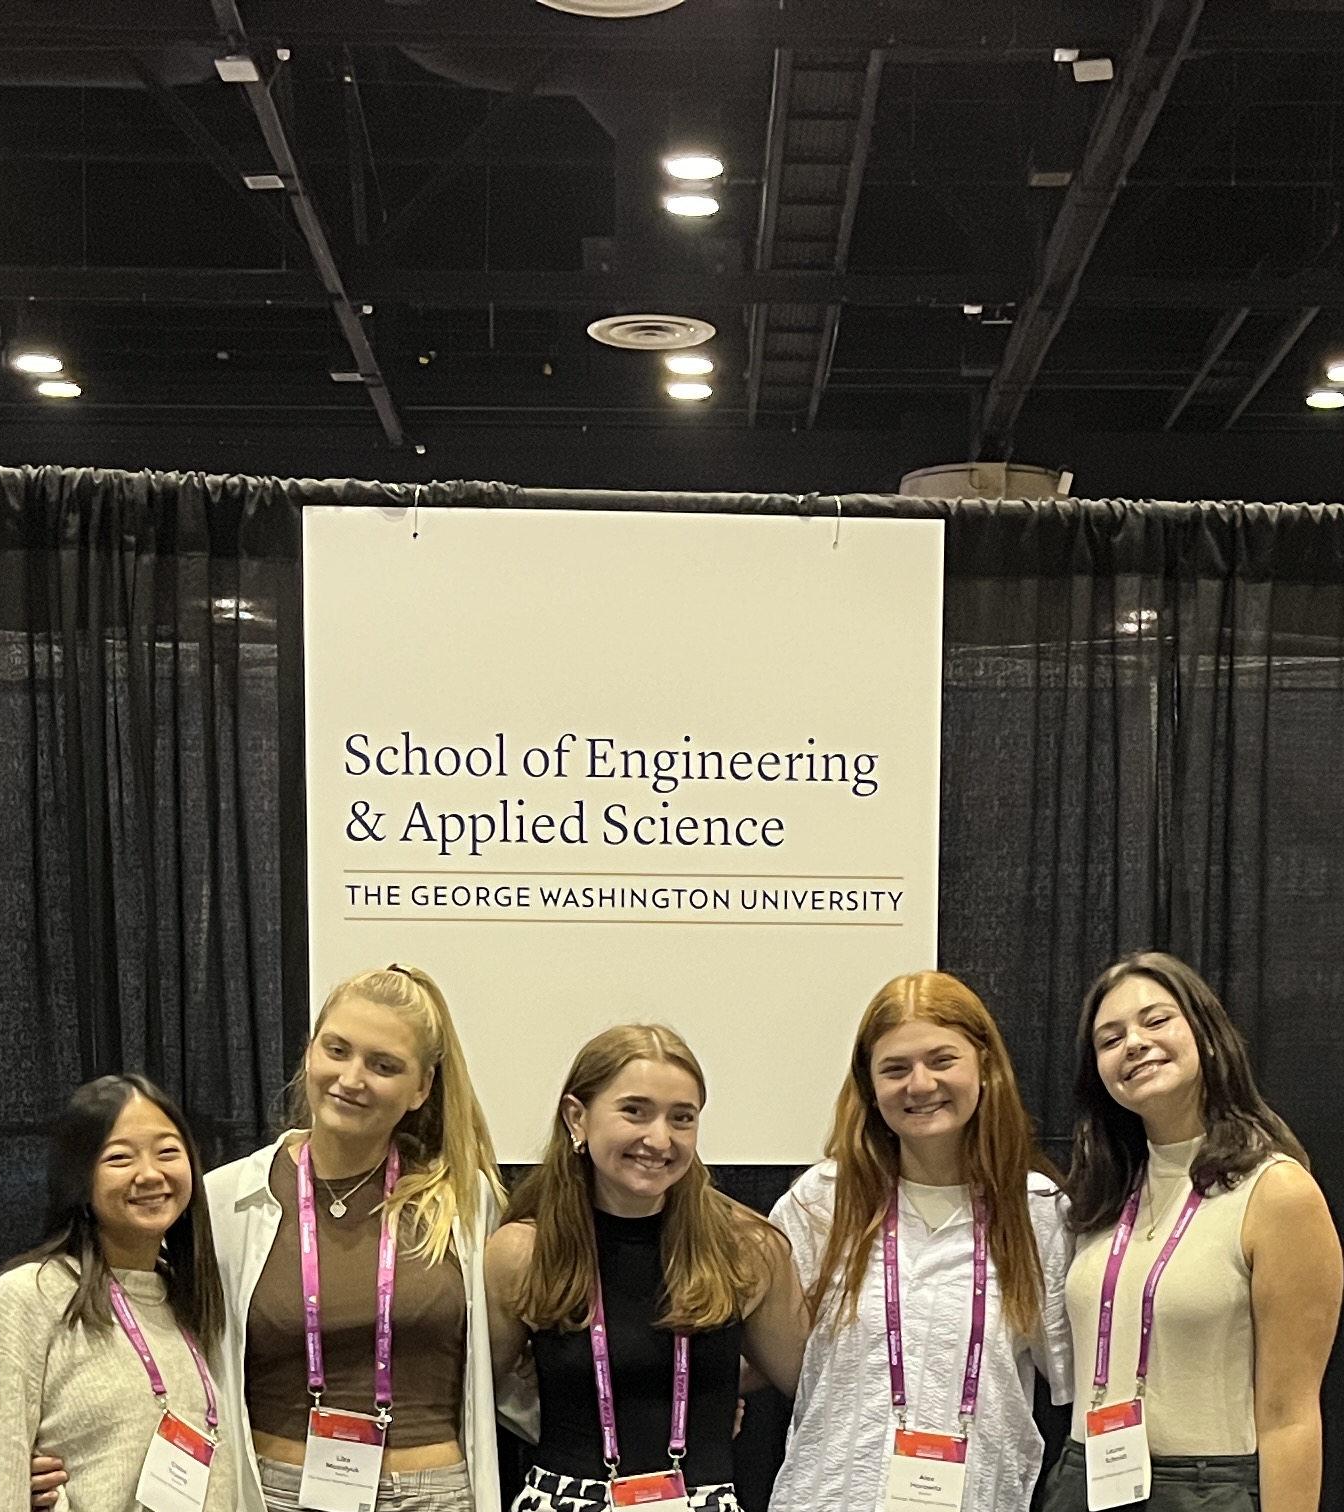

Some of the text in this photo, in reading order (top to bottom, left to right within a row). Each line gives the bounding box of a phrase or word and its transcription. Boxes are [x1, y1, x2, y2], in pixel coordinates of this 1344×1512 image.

[343, 731, 880, 798] School of Engineering
[345, 798, 786, 857] & Applied Science
[345, 884, 904, 913] THE GEORGE WASHINGTON UNIVERSITY
